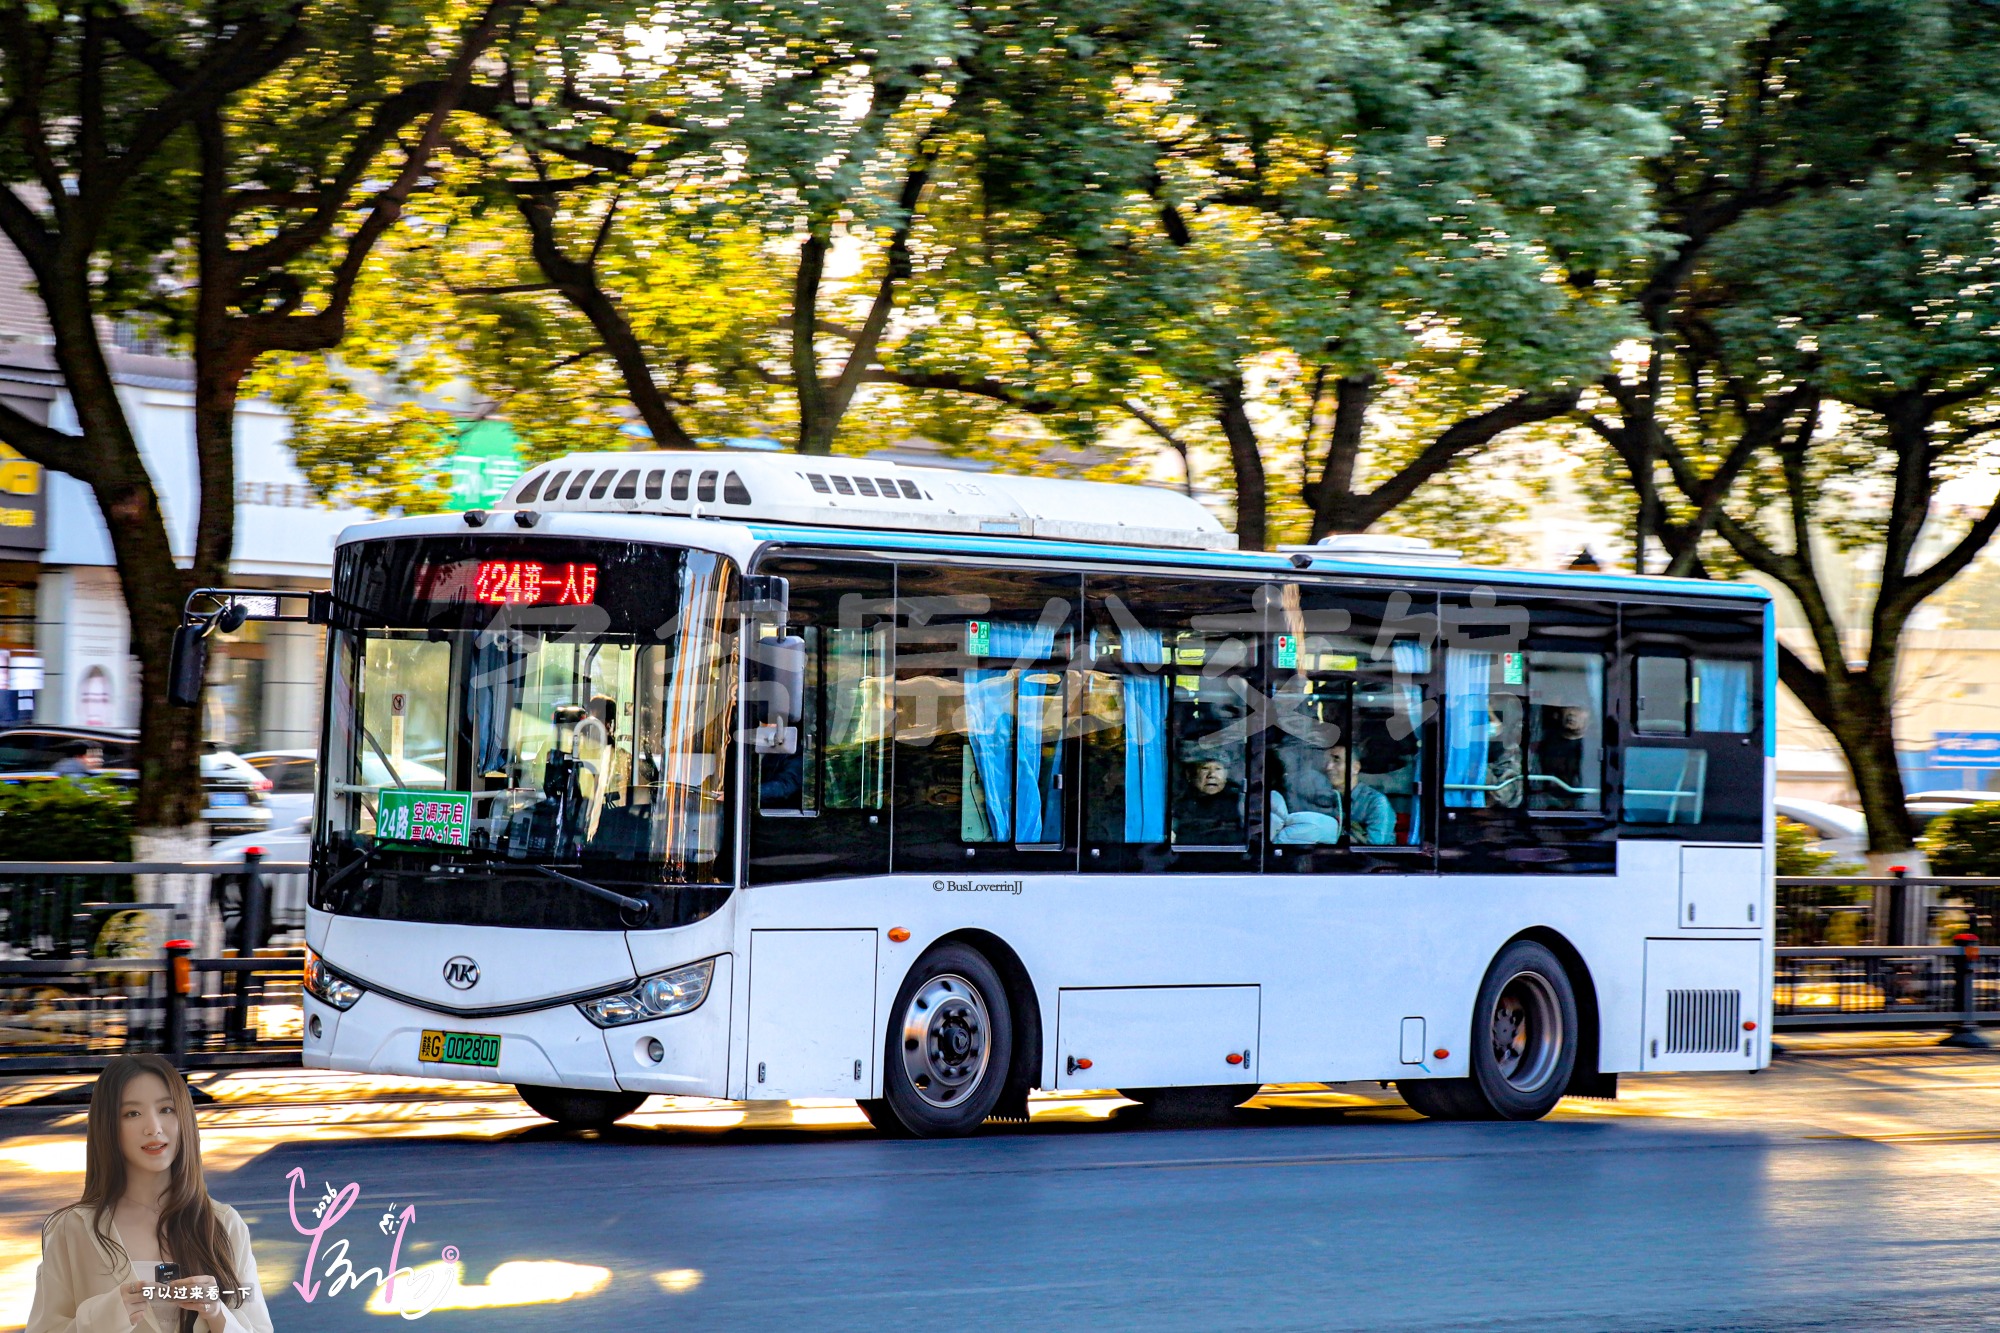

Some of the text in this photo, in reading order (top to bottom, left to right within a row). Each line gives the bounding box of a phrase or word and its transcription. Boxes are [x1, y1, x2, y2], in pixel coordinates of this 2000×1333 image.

[380, 805, 410, 840] 24路
[412, 800, 464, 825] 空调开启
